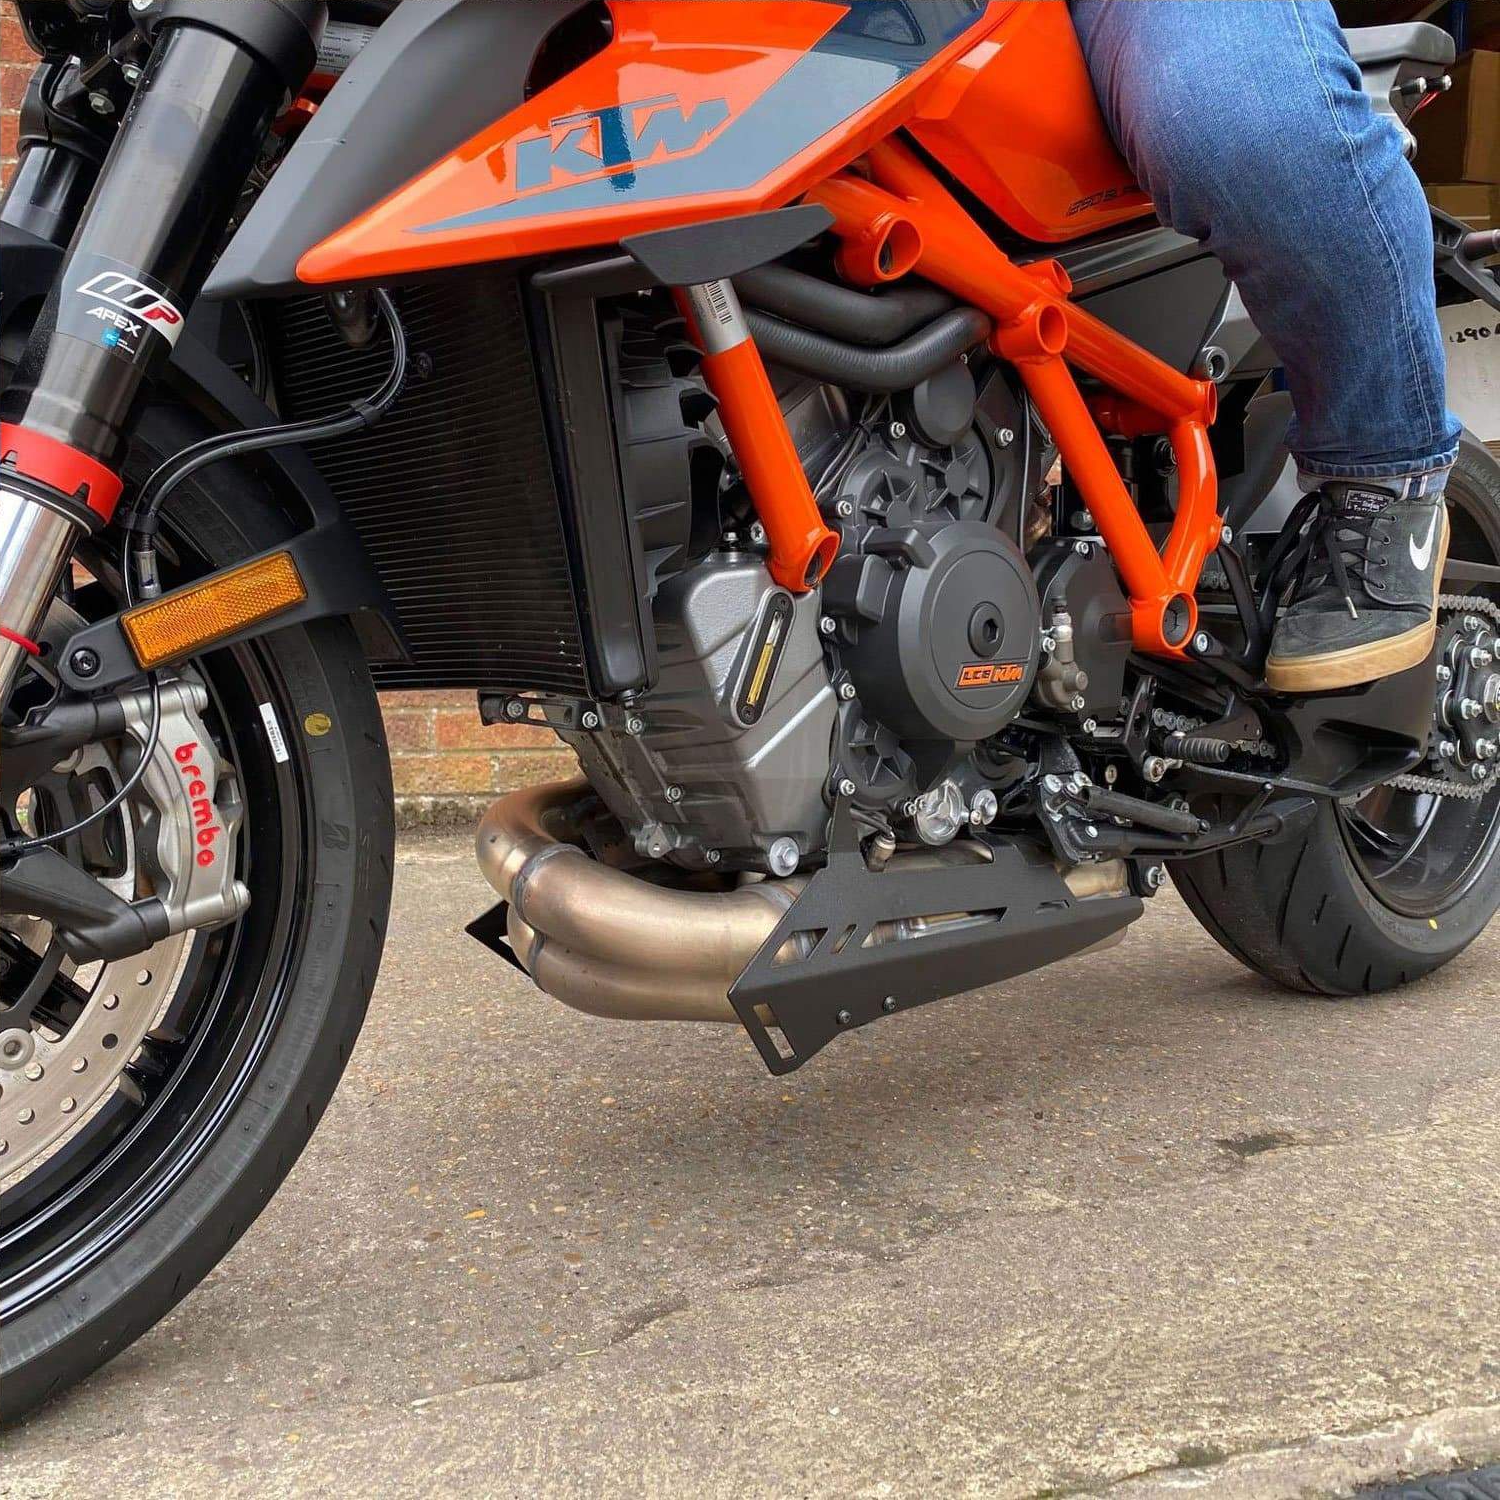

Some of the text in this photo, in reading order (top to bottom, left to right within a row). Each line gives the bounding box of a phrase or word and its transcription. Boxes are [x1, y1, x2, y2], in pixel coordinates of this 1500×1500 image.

[515, 92, 731, 194] KTM
[84, 306, 142, 338] APEX
[174, 742, 221, 868] brembo
